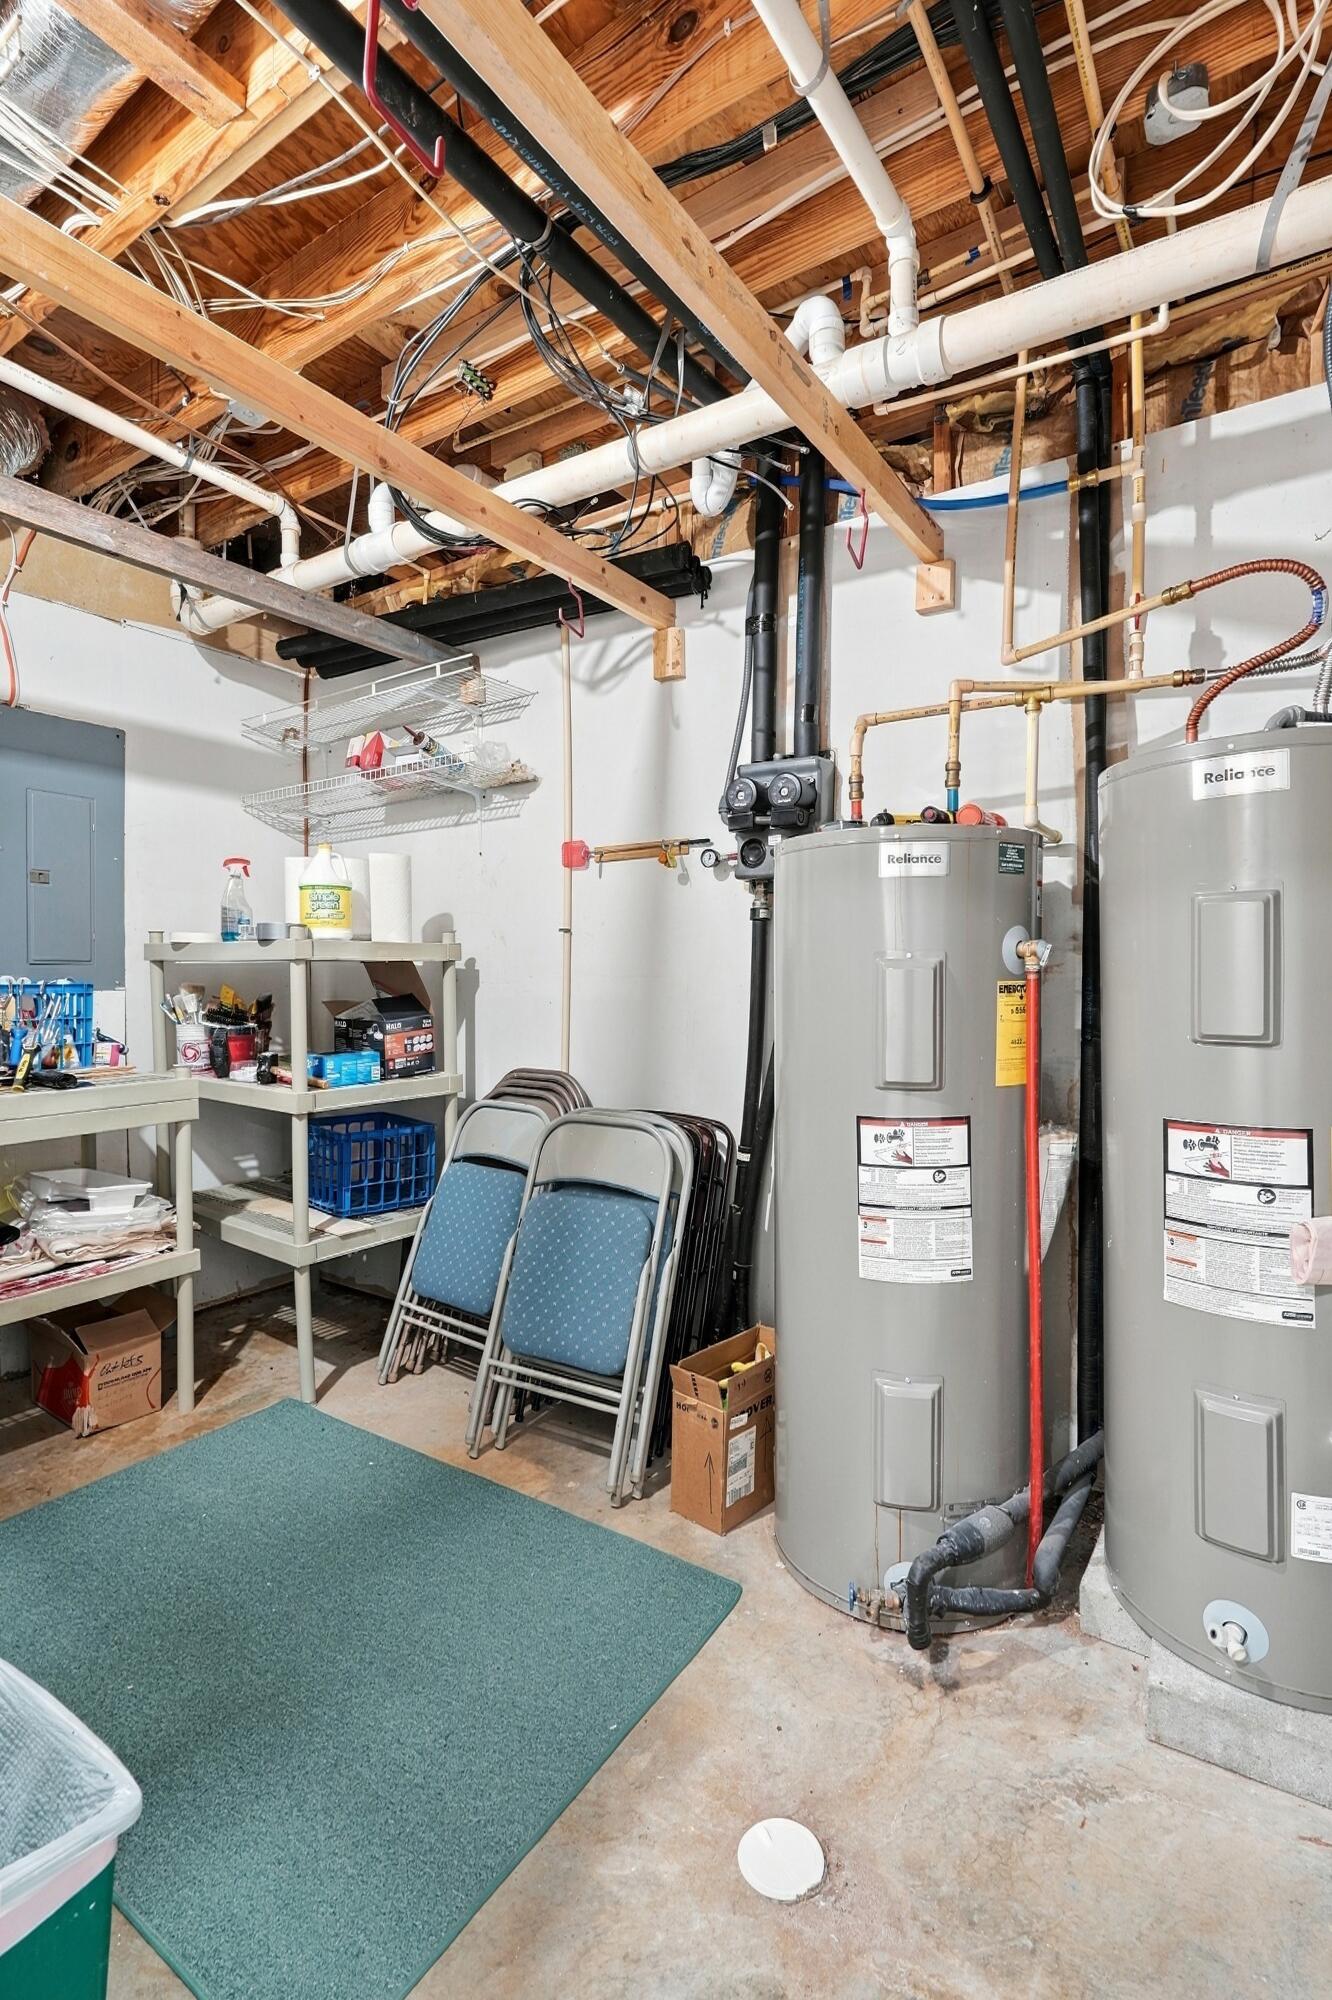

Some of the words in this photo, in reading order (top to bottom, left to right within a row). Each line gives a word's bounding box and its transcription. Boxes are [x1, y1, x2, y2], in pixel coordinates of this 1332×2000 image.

[887, 853, 942, 864] Reliance
[310, 891, 340, 902] simple
[311, 900, 340, 912] green
[386, 1022, 402, 1030] HALO
